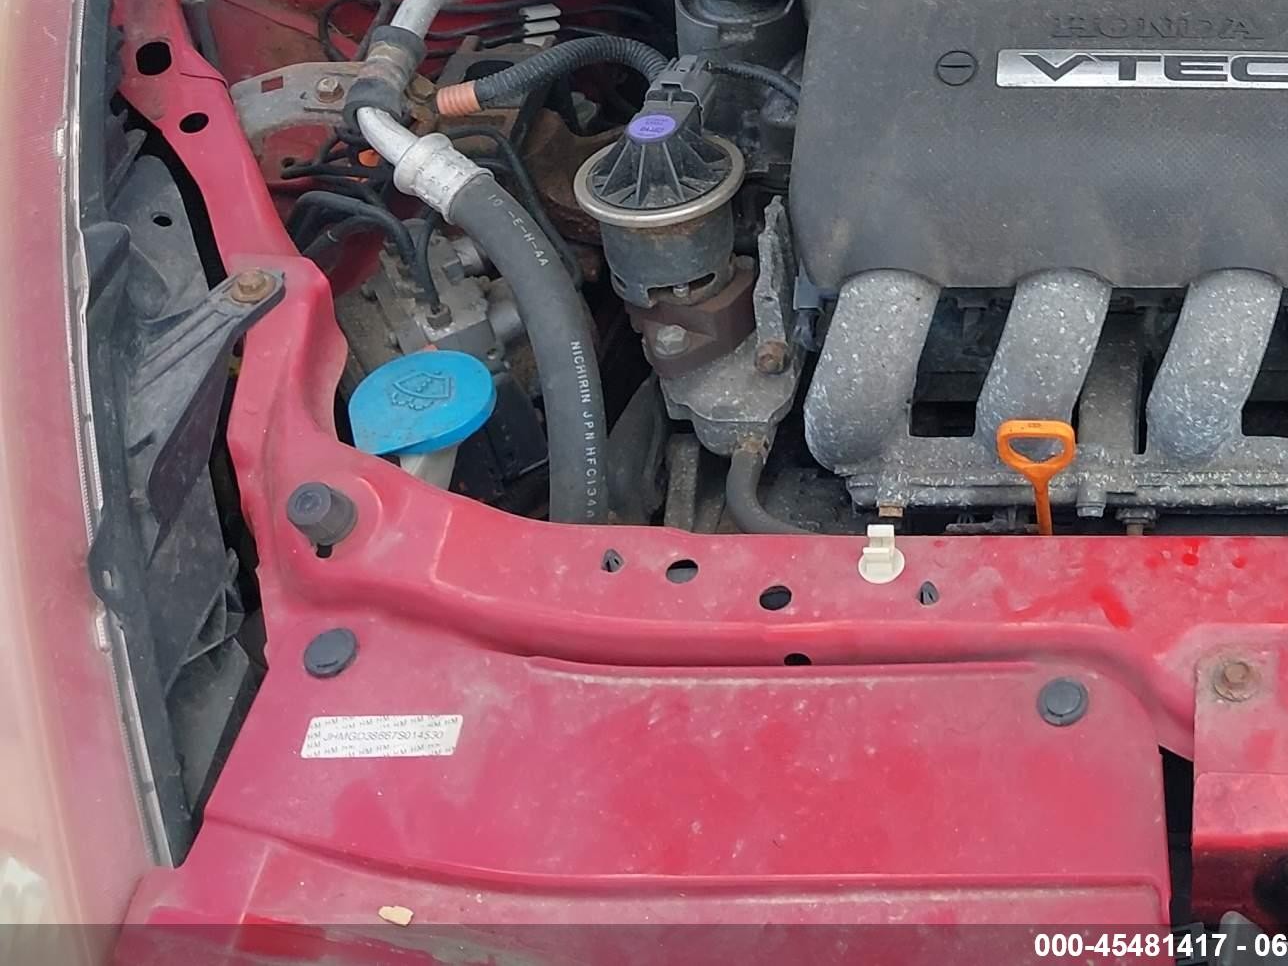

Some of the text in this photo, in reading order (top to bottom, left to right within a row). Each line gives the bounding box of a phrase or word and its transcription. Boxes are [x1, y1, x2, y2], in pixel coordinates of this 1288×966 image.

[1051, 16, 1265, 40] HONDA
[570, 340, 592, 403] NICHIRIN
[582, 410, 596, 440] JPN
